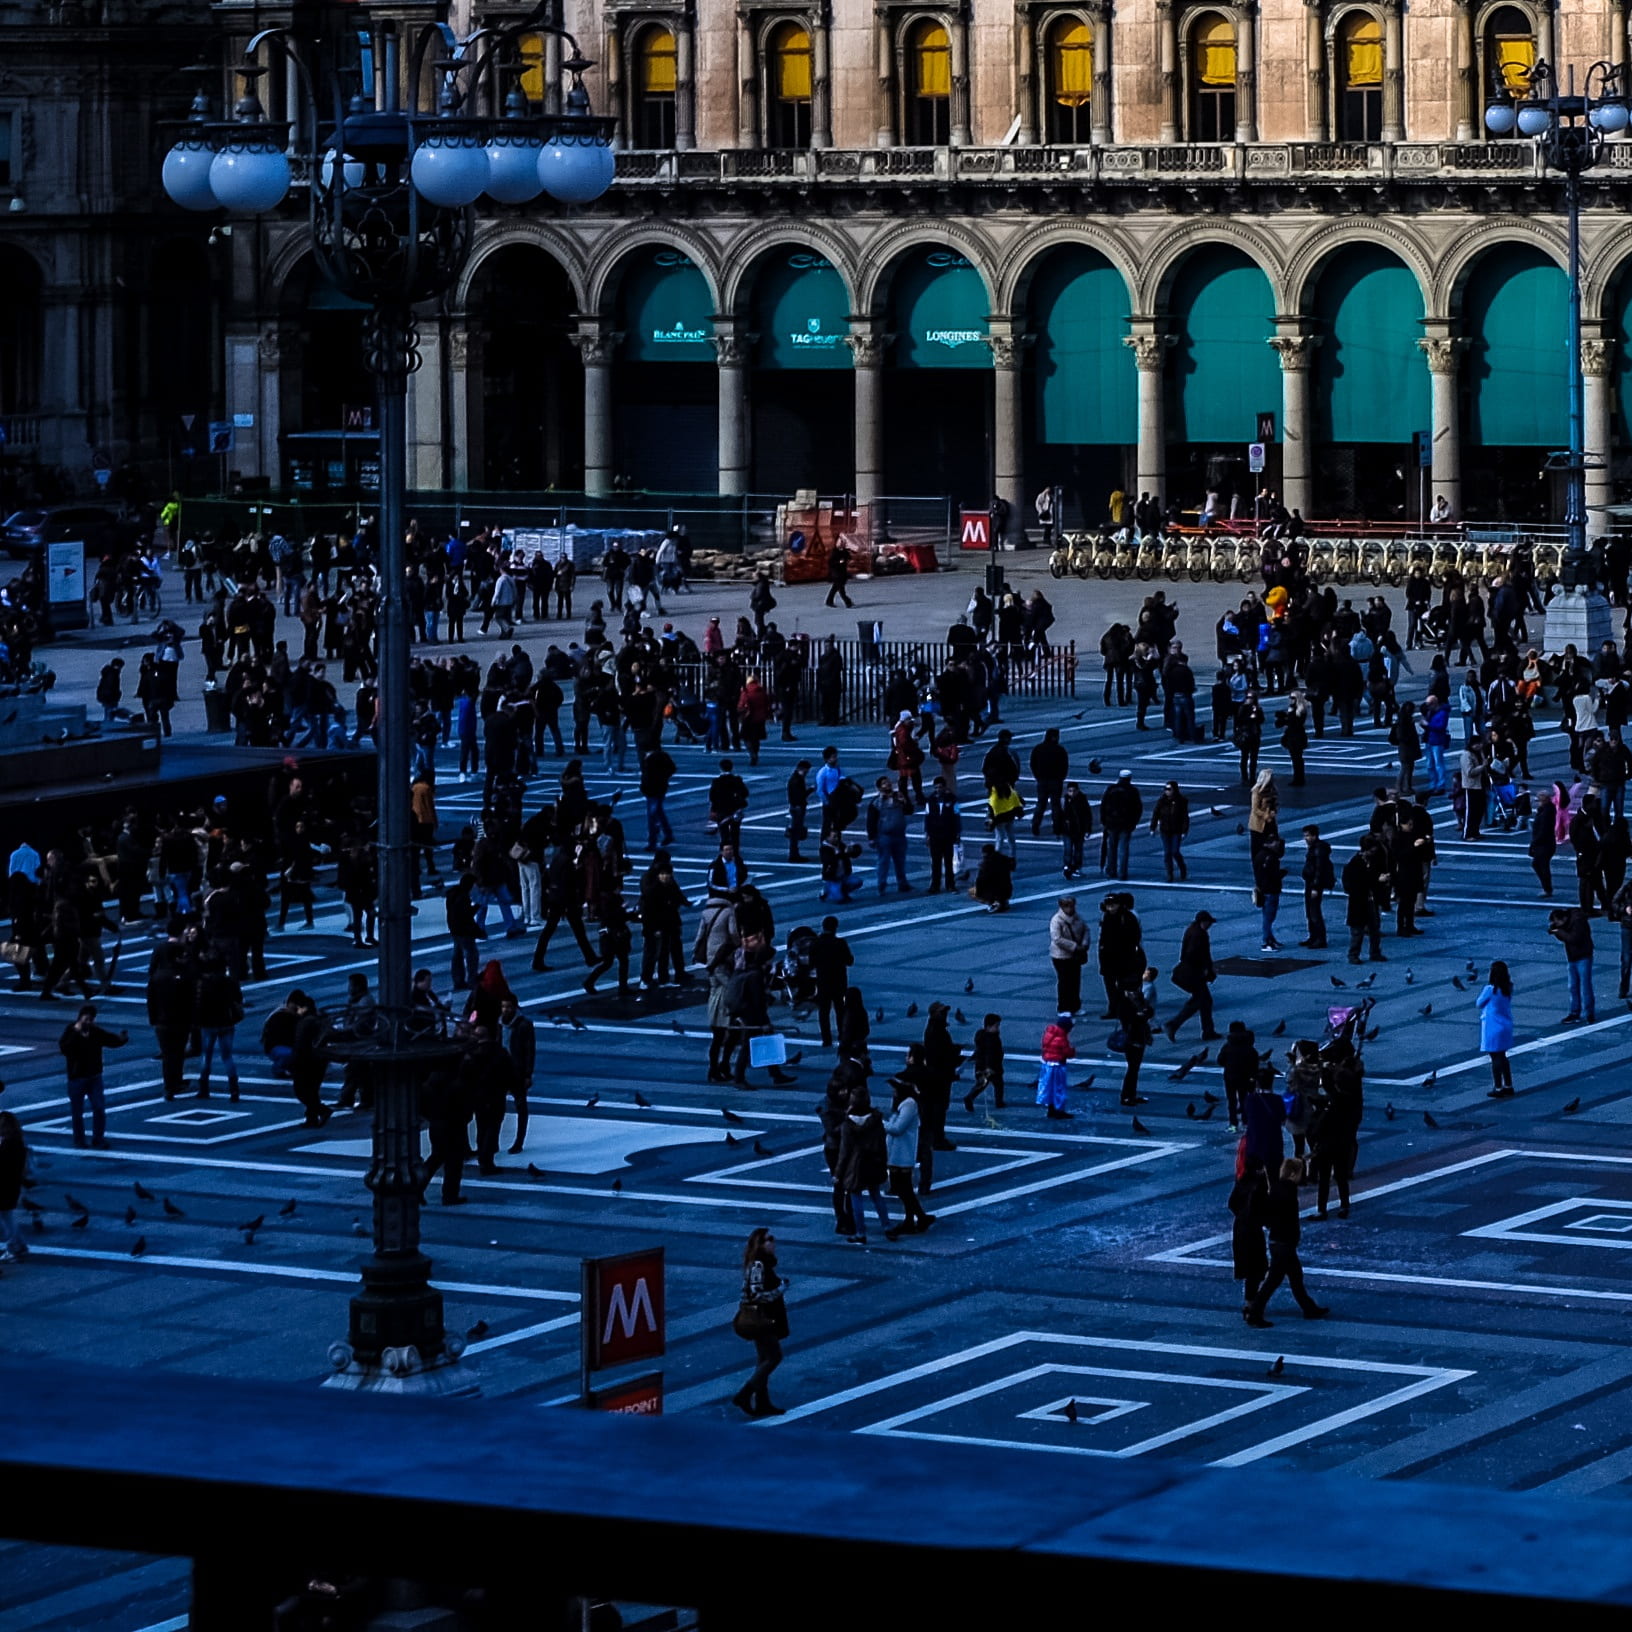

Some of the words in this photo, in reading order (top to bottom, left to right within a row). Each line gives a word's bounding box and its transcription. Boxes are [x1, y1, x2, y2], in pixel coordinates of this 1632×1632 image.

[926, 330, 982, 341] LONGINES
[1261, 419, 1273, 436] M
[962, 520, 987, 543] M
[602, 1277, 658, 1344] M
